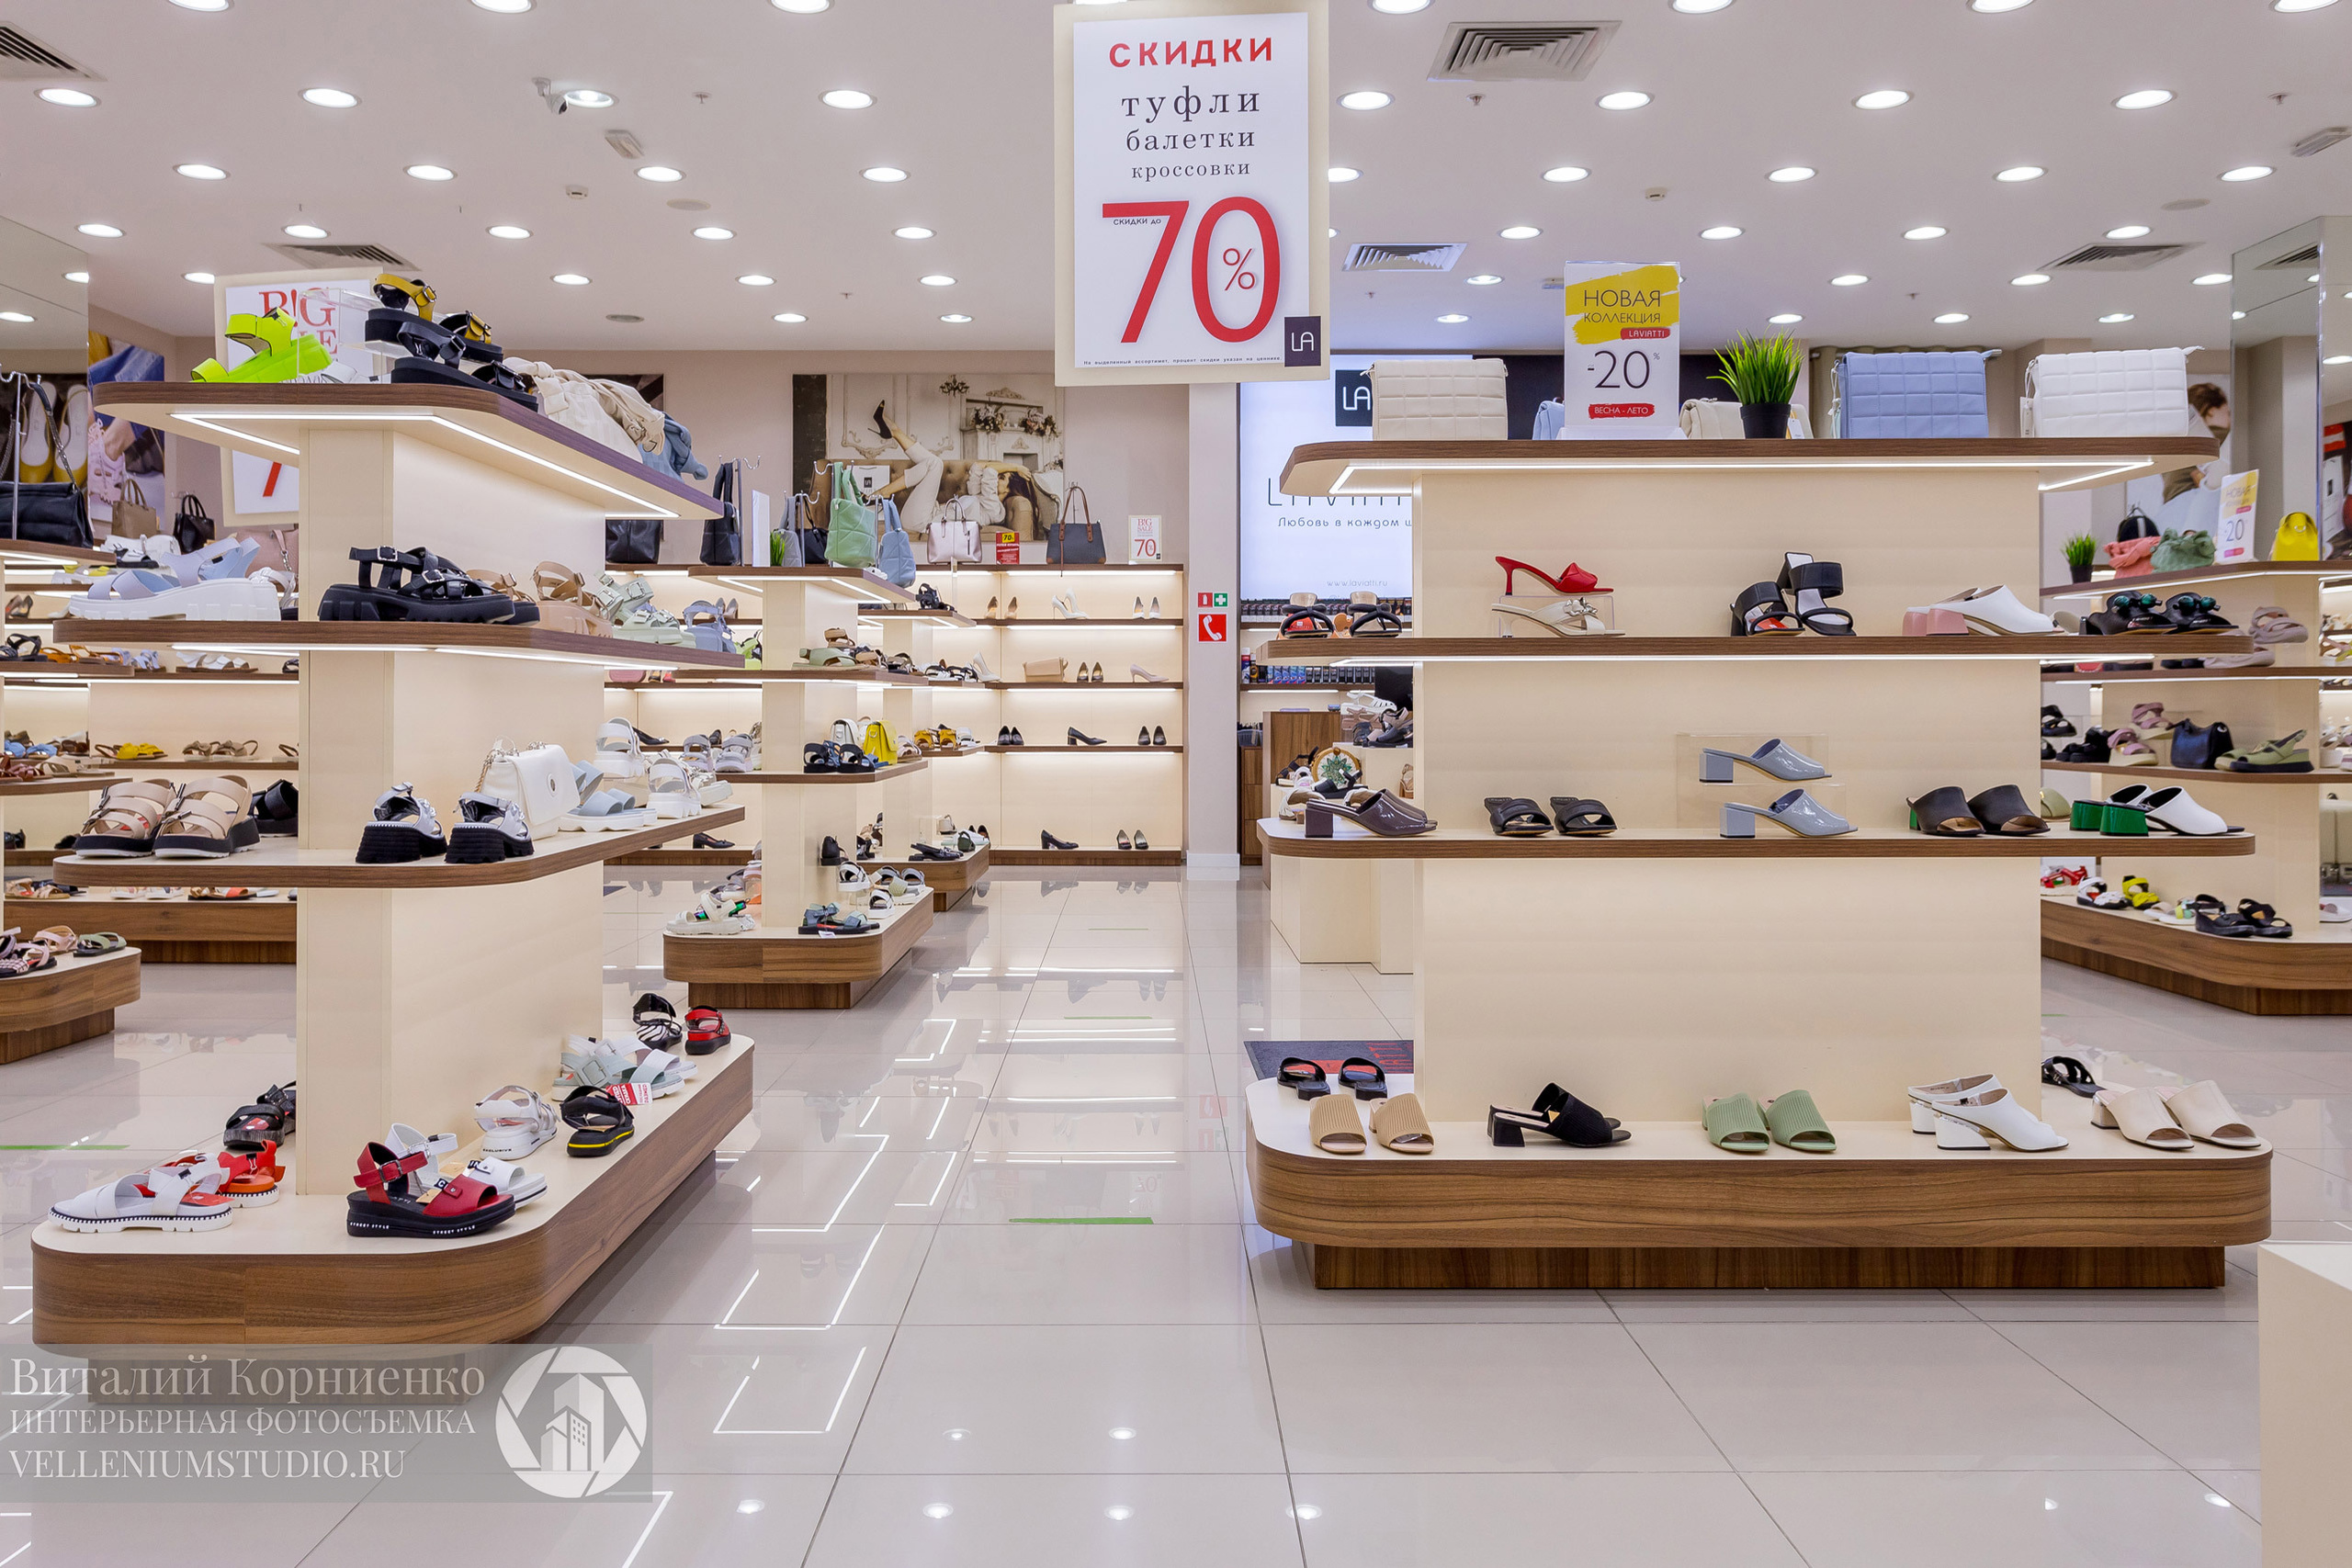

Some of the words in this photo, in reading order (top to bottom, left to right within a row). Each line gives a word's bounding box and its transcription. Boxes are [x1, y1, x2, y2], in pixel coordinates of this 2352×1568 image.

[1109, 37, 1272, 68] СКИДКИ
[1121, 85, 1261, 123] туфли
[1126, 128, 1255, 152] балетки
[1131, 162, 1250, 182] кроссовки
[1584, 289, 1661, 308] НОВАЯ
[1583, 312, 1661, 324] КОЛЛЕКЦИЯ
[1291, 331, 1315, 353] LA
[1628, 330, 1665, 338] LAVIATTI
[1342, 386, 1372, 412] LA
[1594, 406, 1621, 414] ВЕСНА
[1626, 406, 1649, 414] ЛЕТО
[1278, 516, 1329, 527] Любовь
[1347, 519, 1399, 529] каждом
